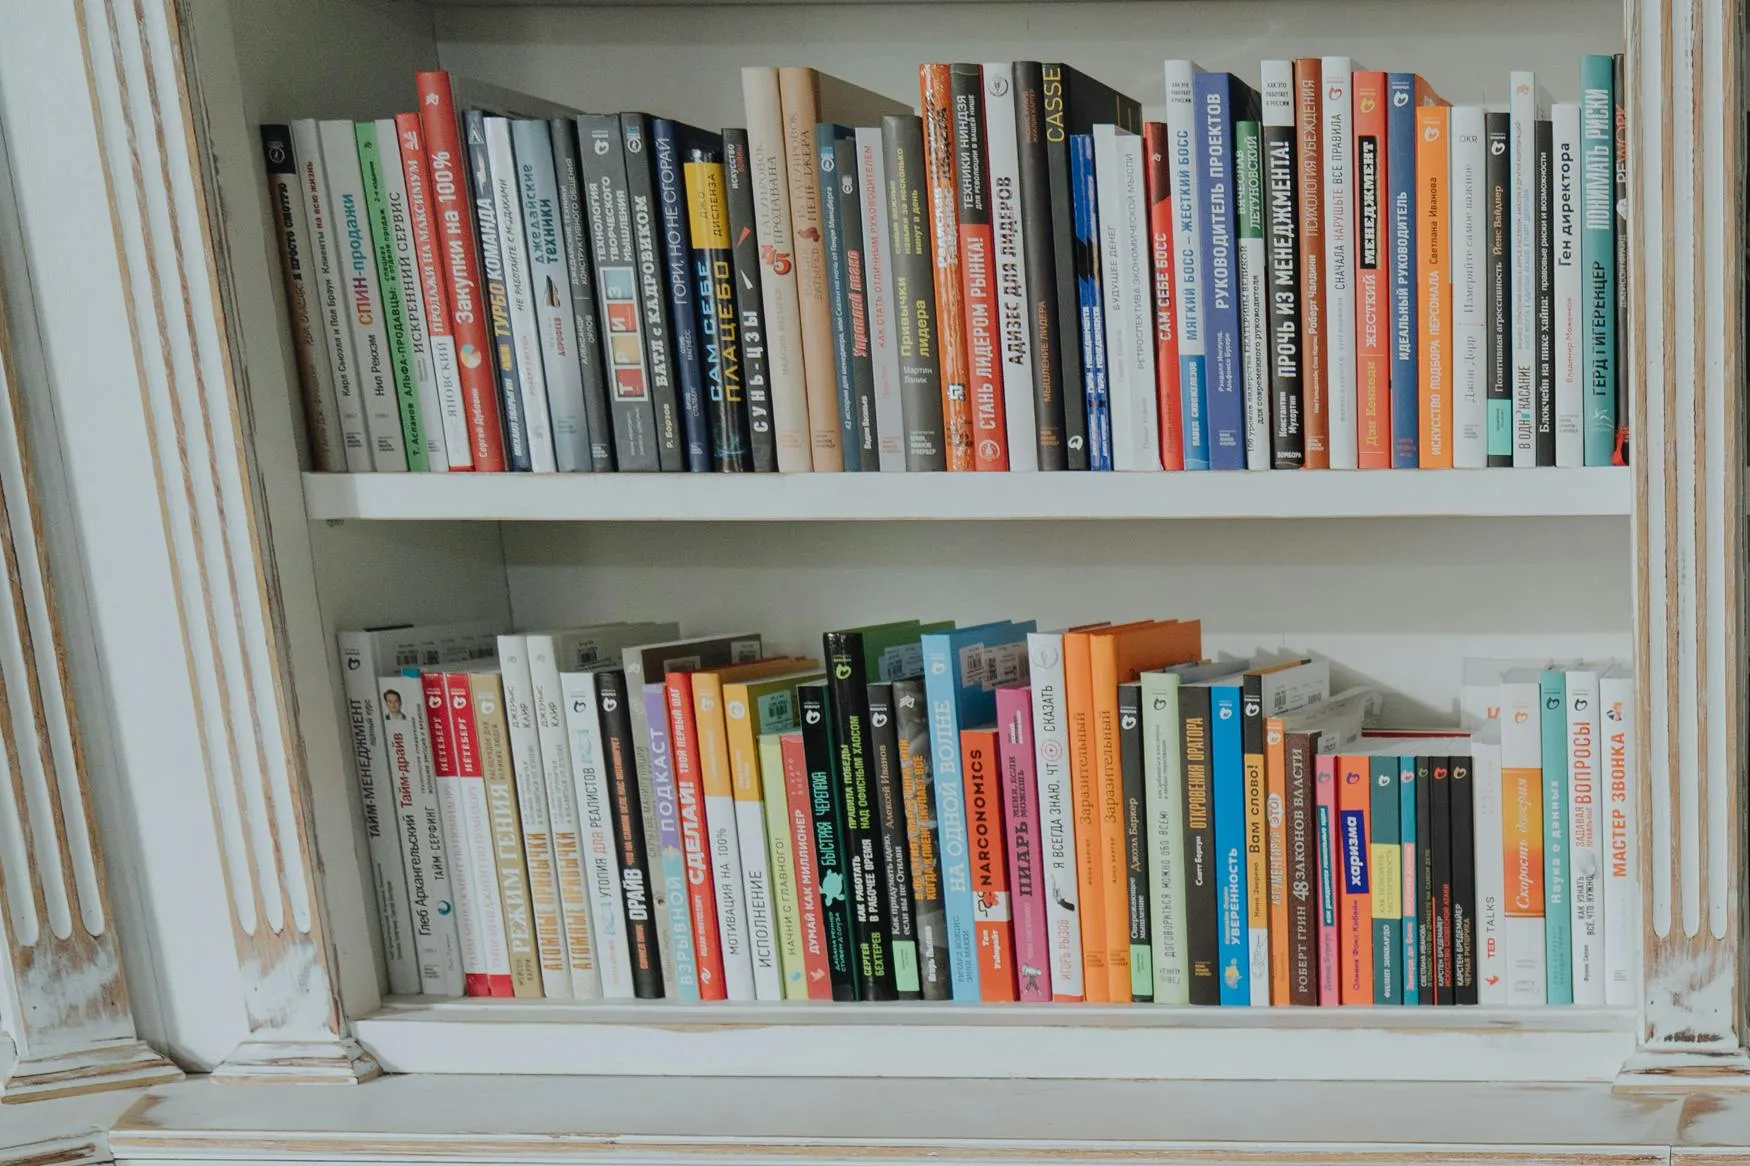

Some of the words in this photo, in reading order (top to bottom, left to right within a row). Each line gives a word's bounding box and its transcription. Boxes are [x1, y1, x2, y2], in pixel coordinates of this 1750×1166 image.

[1208, 93, 1224, 178] ПРОЕКТОВ
[1303, 80, 1317, 157] УБЕЖДЕНИЯ
[1585, 89, 1608, 139] РИСКИ
[432, 151, 457, 203] 100%
[656, 137, 677, 203] СГОРАЙ
[1177, 130, 1189, 165] БОСС
[1178, 170, 1192, 232] ЖЕСТКИЙ
[1304, 160, 1319, 237] ПСИХОЛОГИЯ
[1362, 141, 1376, 265] МЕНЕДЖМЕНТ
[1539, 152, 1549, 211] возможности
[1558, 143, 1572, 235] директора
[1586, 146, 1610, 229] ПОНИМАТЬ
[389, 191, 409, 252] СЕРВИС
[444, 211, 461, 235] на
[477, 198, 504, 280] КОМАНДА
[665, 207, 679, 228] НЕ
[667, 231, 683, 256] НО
[996, 176, 1016, 257] ЛИДЕРОВ
[1270, 141, 1295, 285] МЕНЕДЖМЕНТА!
[1540, 223, 1548, 248] риски
[341, 193, 374, 326] СПИН-продажи
[635, 195, 662, 323] КАДРОВИКОМ
[967, 236, 986, 298] РЫНКА!
[1182, 249, 1194, 283] БОСС
[1211, 183, 1230, 309] РУКОВОДИТЕЛЬ
[1539, 252, 1548, 291] правовые
[1559, 240, 1571, 266] Ген
[397, 256, 424, 353] ИСКРЕННИЙ
[445, 239, 475, 324] Закупки
[489, 282, 511, 337] ТУРБО
[669, 260, 687, 305] ГОРИ,
[1003, 262, 1021, 297] ДЛЯ
[1274, 290, 1294, 315] ИЗ
[1363, 274, 1377, 347] ЖЕСТКИЙ
[714, 260, 742, 402] ПЛАЦЕБО
[971, 303, 993, 378] ЛИДЕРОМ
[1004, 302, 1026, 365] АДИЗЕС
[1183, 288, 1197, 340] МЯГКИЙ
[1538, 296, 1550, 331] хайпа:
[651, 340, 669, 387] БАТЛ
[744, 310, 769, 432] СУНЬ-ЦЗЫ
[1275, 320, 1297, 378] ПРОЧЬ
[1540, 335, 1550, 360] пике
[1541, 363, 1550, 375] на
[977, 383, 996, 429] СТАНЬ
[1538, 379, 1551, 433] Блокчейн
[392, 733, 413, 808] Тайм-драйв
[1186, 718, 1204, 761] ОРАТОРА
[1573, 722, 1592, 804] ВОПРОСЫ
[1610, 733, 1625, 802] ЗВОНКА
[651, 728, 675, 832] ПОДКАСТ
[1187, 765, 1207, 829] ОТКРОВЕНИЯ
[1291, 748, 1304, 807] ВЛАСТИ
[491, 783, 518, 859] ГЕНИЯ
[680, 781, 704, 885] СДЕЛАЙ!
[716, 828, 729, 857] 100%
[794, 810, 811, 884] МИЛЛИОНЕР
[971, 749, 992, 886] NARCONOMICS
[1294, 810, 1306, 879] ЗАКОНОВ
[1611, 808, 1626, 877] МАСТЕР
[405, 815, 429, 907] Архангельский
[721, 863, 732, 879] НА
[1346, 816, 1362, 887] харизма
[417, 909, 431, 935] Глеб
[501, 867, 529, 952] РЕЖИМ
[723, 884, 740, 955] МОТИВАЦИЯ
[802, 886, 814, 909] КАК
[1227, 848, 1241, 944] УВЕРЕННОСТЬ
[1292, 882, 1310, 901] 48
[1485, 896, 1495, 932] TALKS
[807, 912, 820, 954] ДУМАЙ
[1297, 906, 1307, 940] ГРИН
[1487, 937, 1496, 958] TED
[1298, 944, 1309, 993] РОБЕРТ
